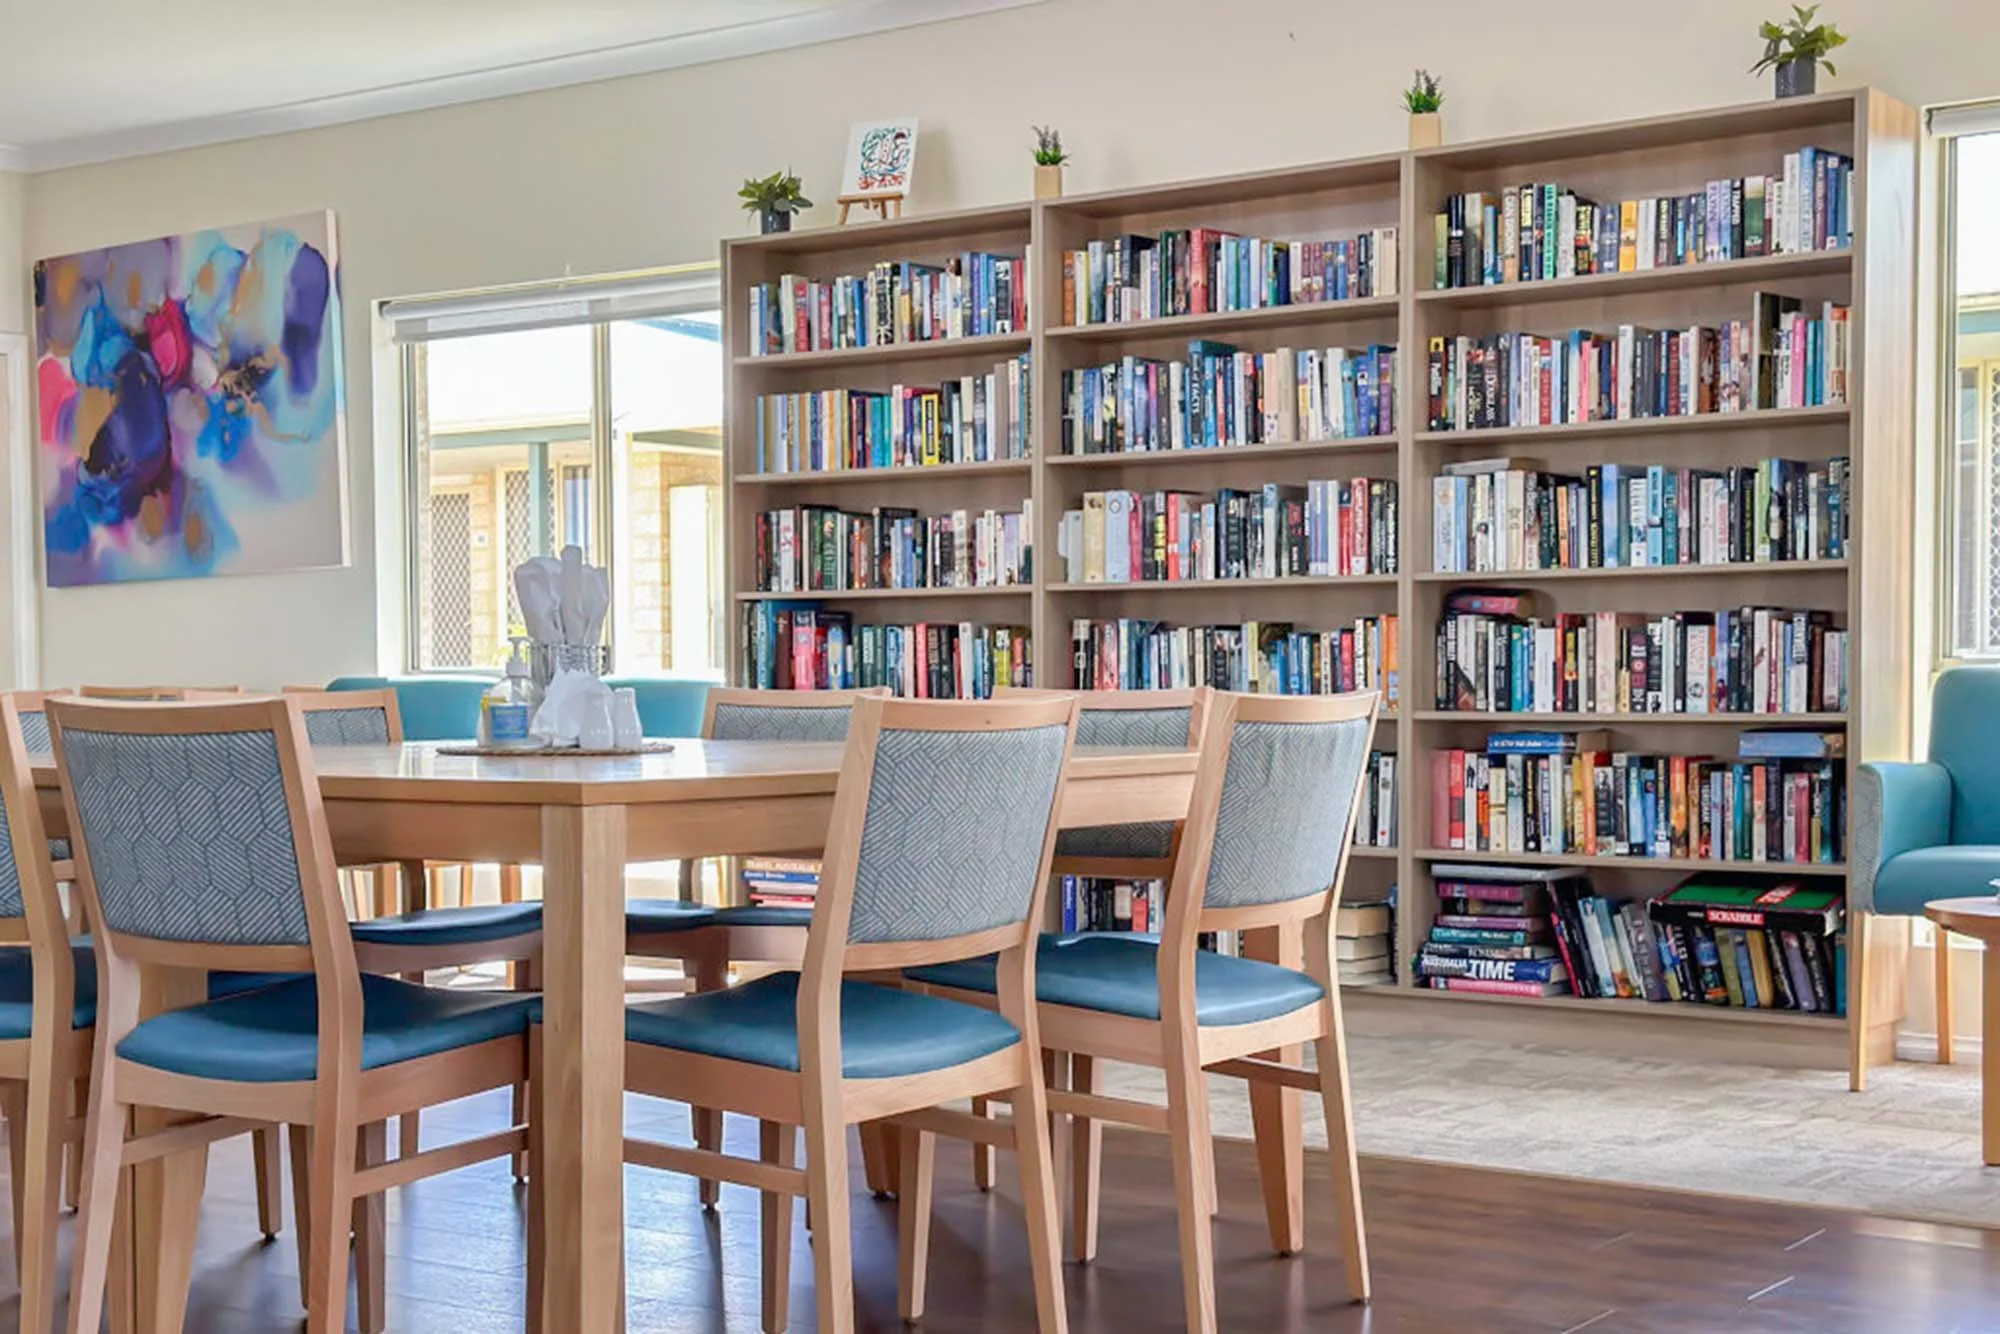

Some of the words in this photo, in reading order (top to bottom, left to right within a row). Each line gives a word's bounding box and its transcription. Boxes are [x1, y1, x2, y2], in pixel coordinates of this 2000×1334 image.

[1191, 382, 1200, 413] FACTS
[1485, 374, 1496, 421] DOUGLASS
[1708, 910, 1764, 925] SCRABBLE
[1467, 960, 1516, 980] TIME
